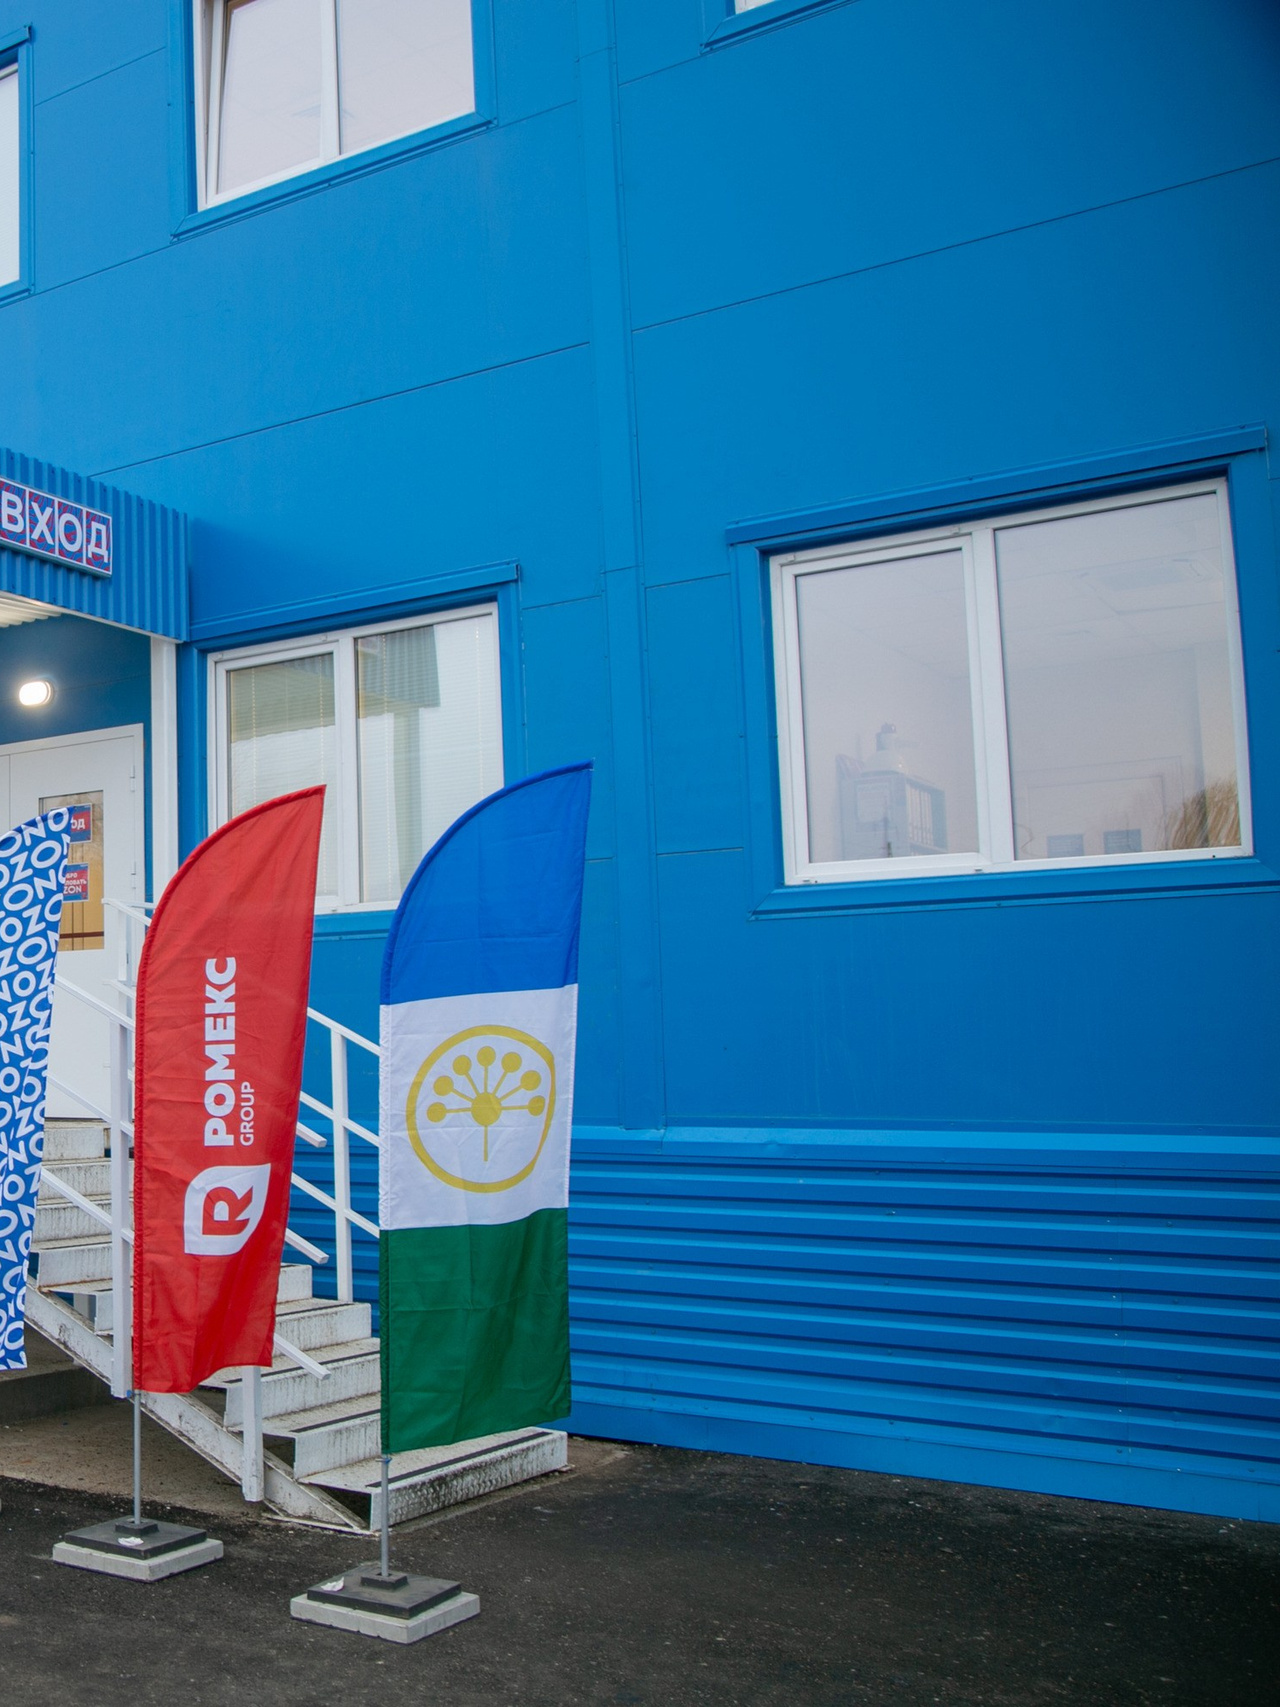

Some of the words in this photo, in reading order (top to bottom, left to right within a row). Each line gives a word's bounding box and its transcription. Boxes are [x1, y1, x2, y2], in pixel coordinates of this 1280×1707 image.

[1, 490, 109, 563] ВХОД
[63, 885, 82, 895] ZON
[204, 957, 237, 1146] РОМЕКС
[240, 1081, 255, 1146] GROUP
